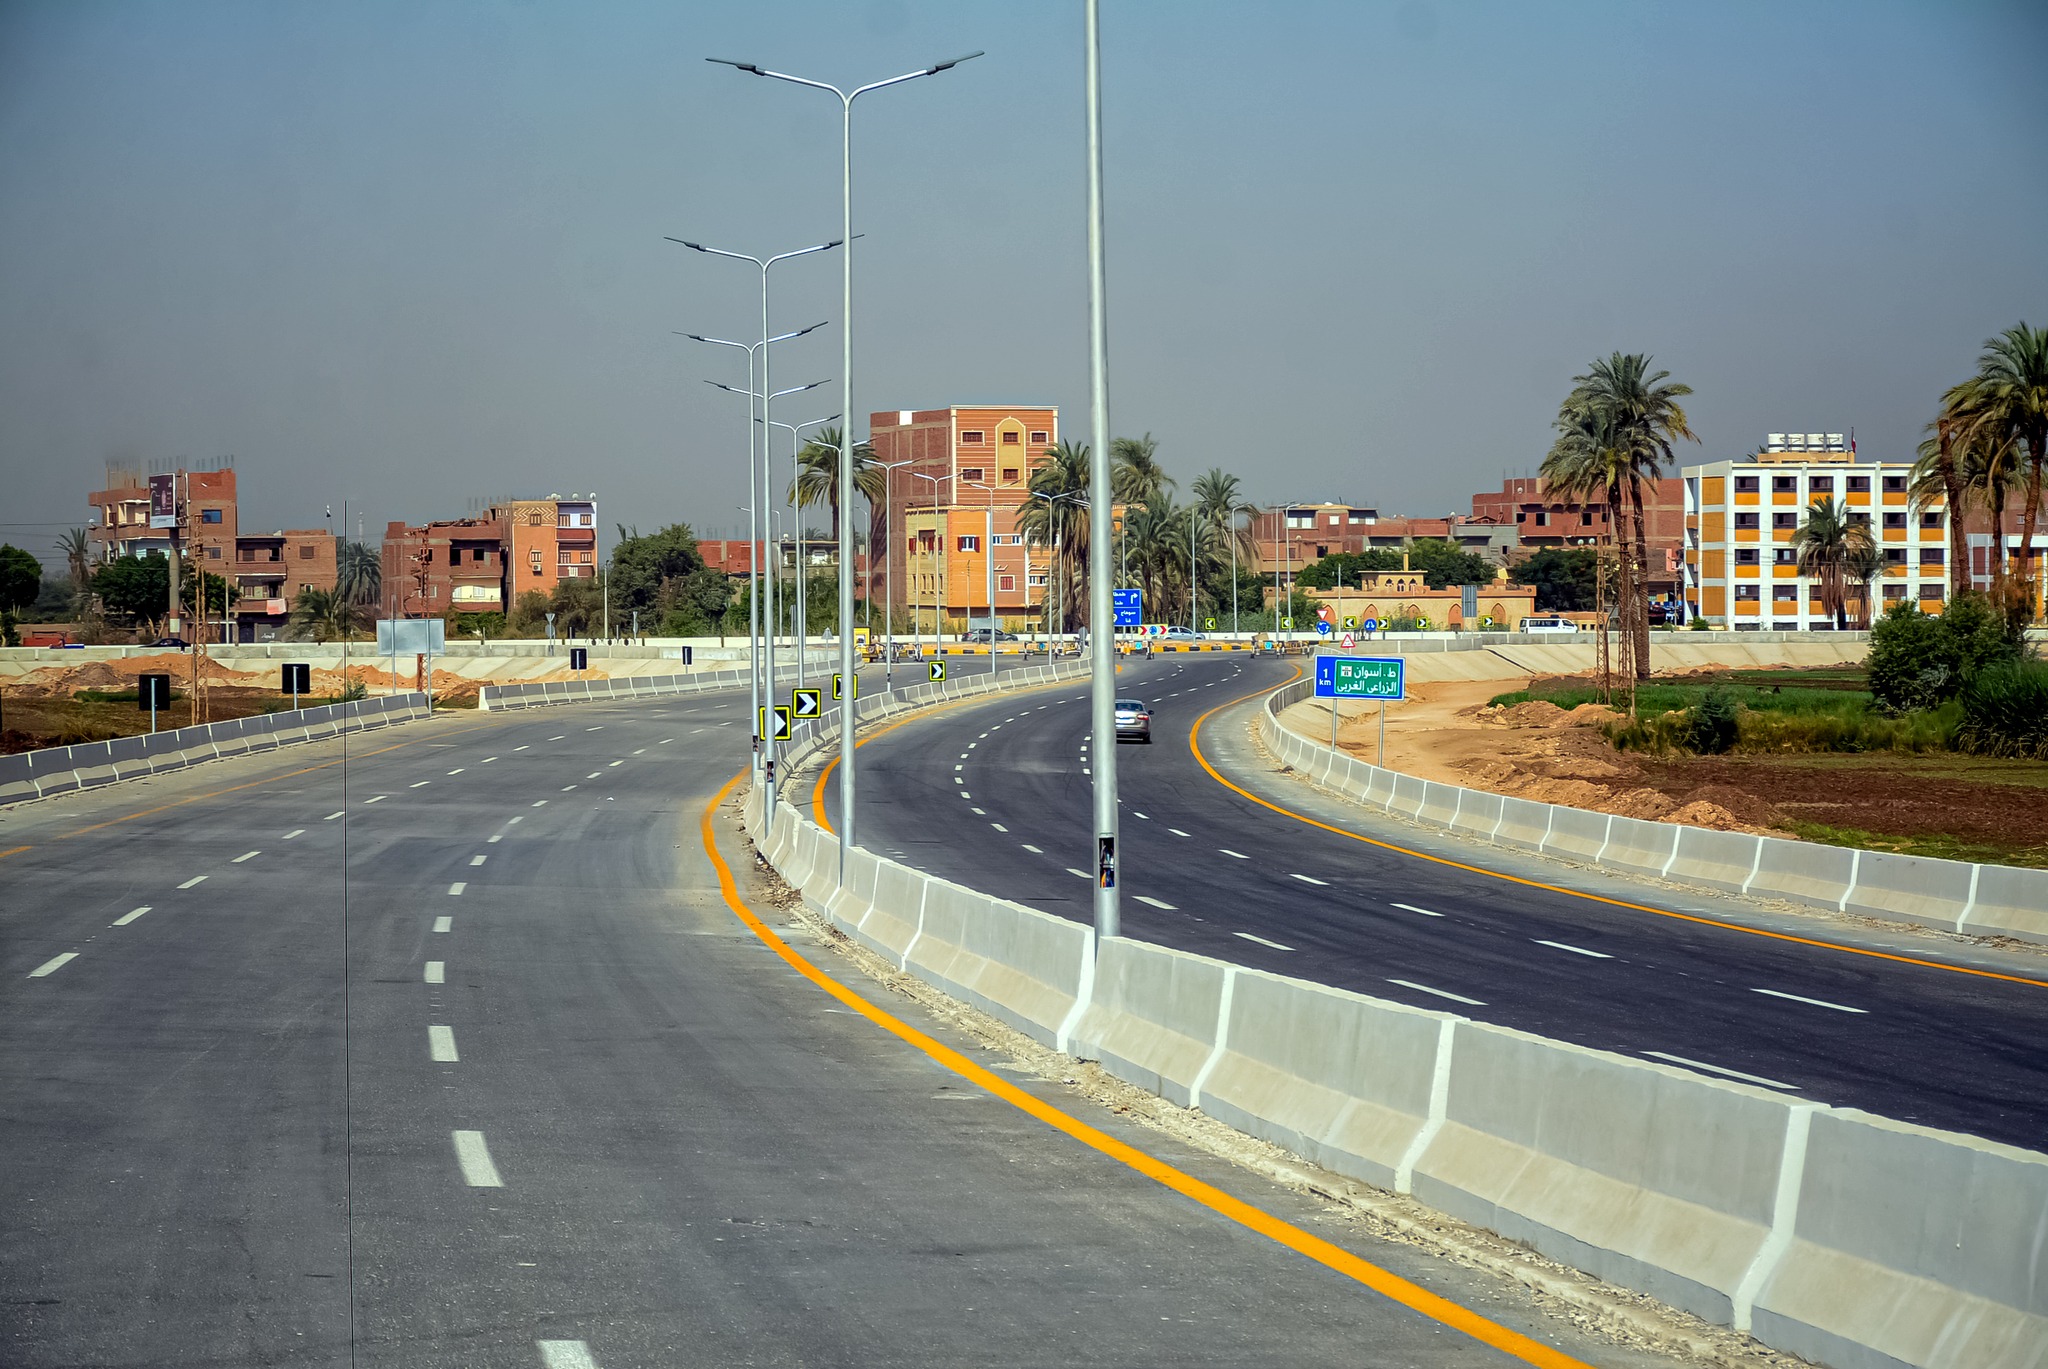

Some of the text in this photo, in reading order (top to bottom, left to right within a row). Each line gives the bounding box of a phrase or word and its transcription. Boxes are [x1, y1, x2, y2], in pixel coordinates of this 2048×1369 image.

[1323, 668, 1328, 679] 1
[1353, 662, 1382, 679] أسوان
[1319, 678, 1331, 686] km
